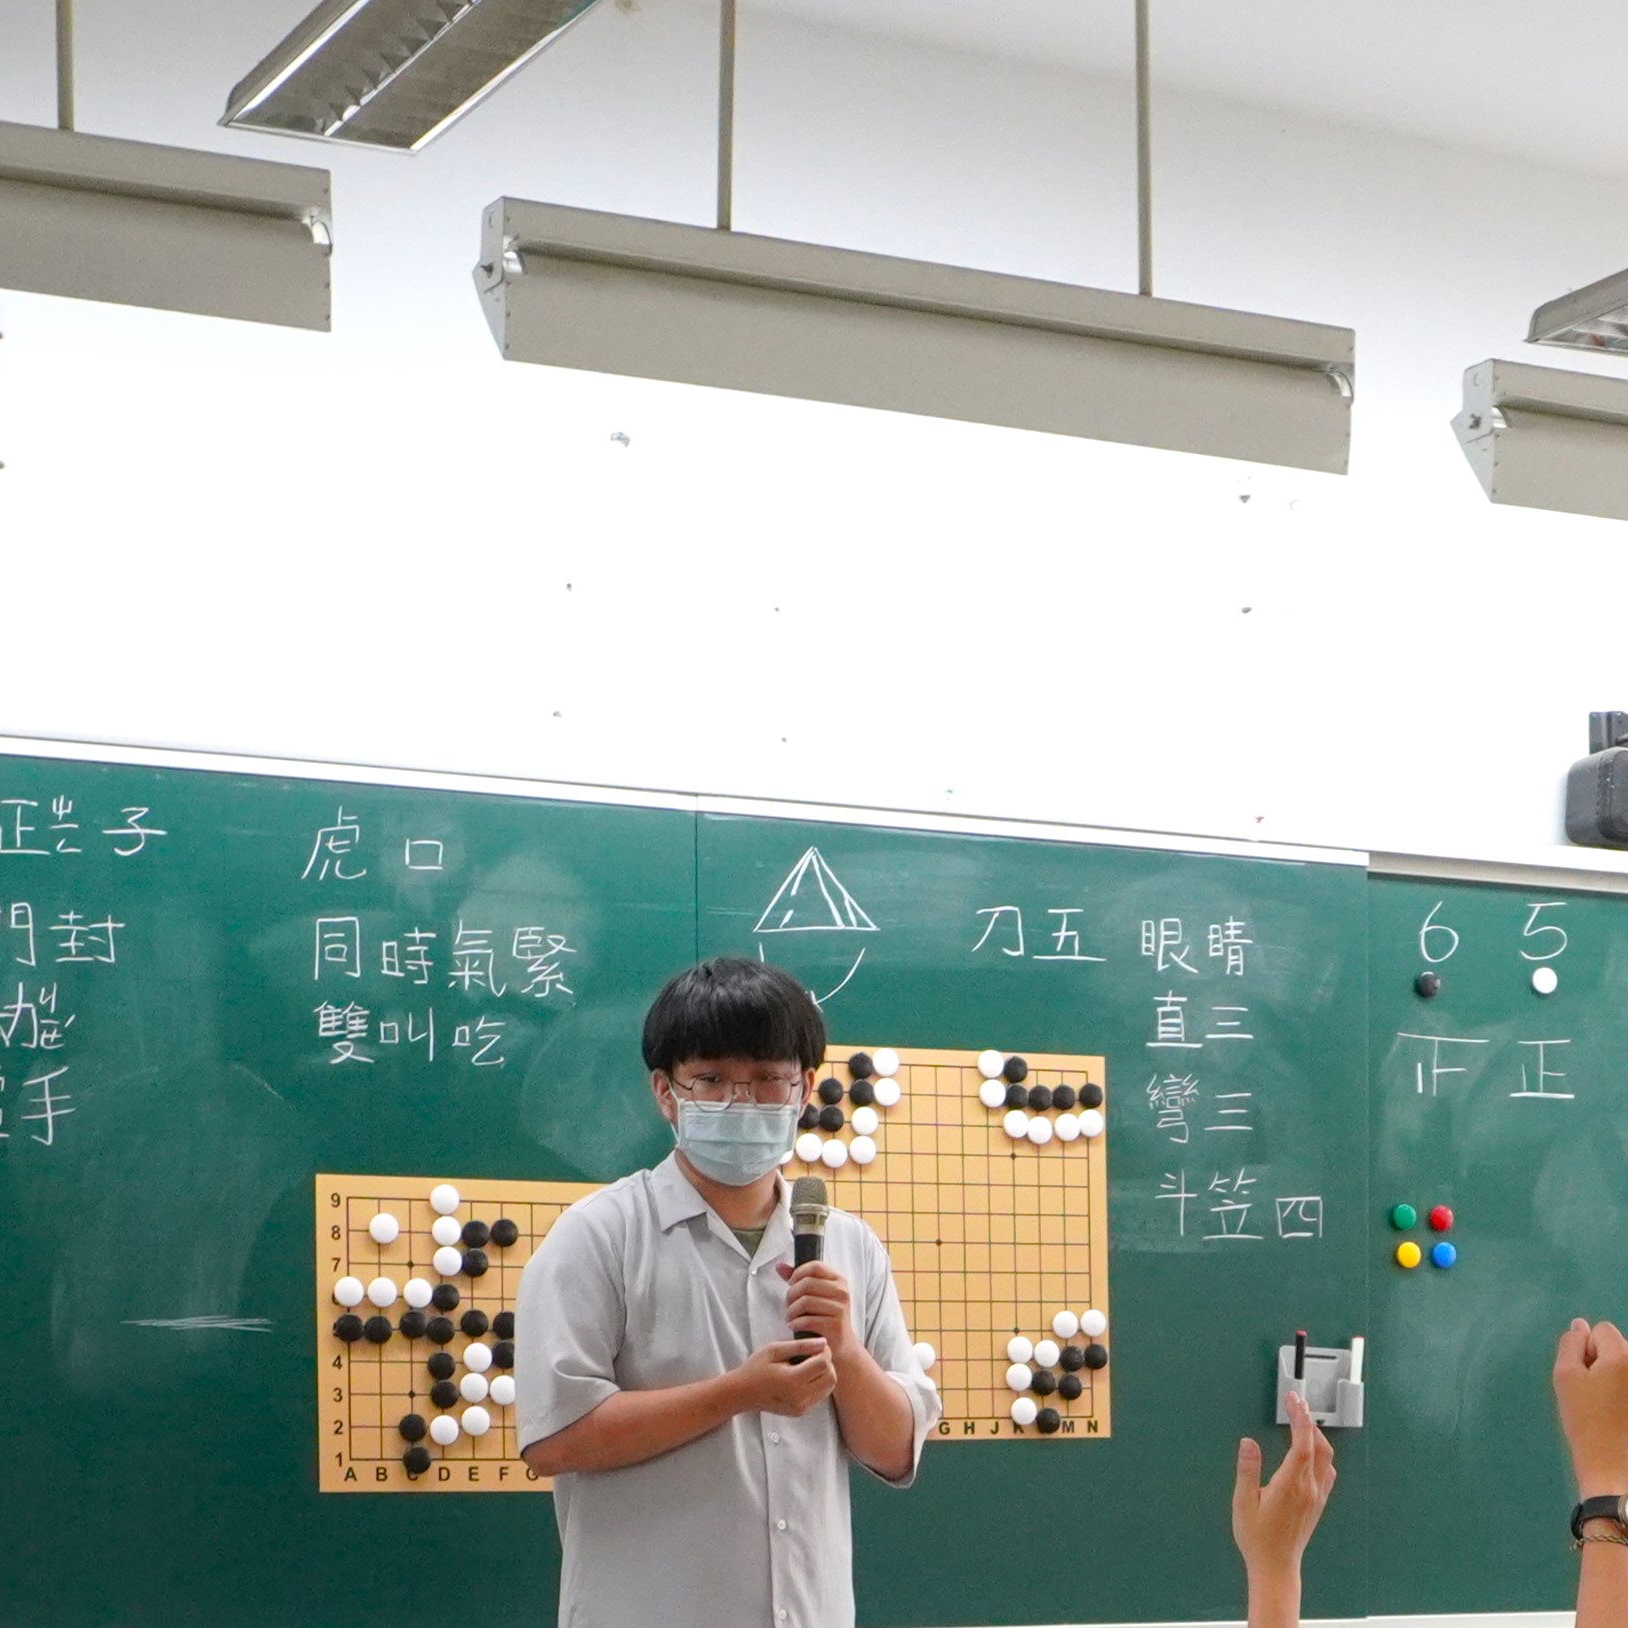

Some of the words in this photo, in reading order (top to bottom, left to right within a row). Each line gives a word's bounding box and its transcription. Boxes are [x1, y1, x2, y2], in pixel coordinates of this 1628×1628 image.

[301, 805, 444, 881] 虎口
[1419, 901, 1460, 963] 6
[1518, 902, 1568, 961] 5
[1141, 916, 1253, 976] 眼睛
[314, 916, 578, 998] 同時氣緊
[1146, 990, 1254, 1048] 直三
[313, 1000, 507, 1065] 雙叫吃
[1146, 1073, 1254, 1144] 彎三
[330, 1194, 341, 1208] 9
[1155, 1167, 1323, 1241] 斗笠四
[331, 1226, 341, 1240] 8
[331, 1258, 342, 1272] 7
[332, 1355, 343, 1369] 4
[333, 1387, 343, 1401] 3
[333, 1420, 344, 1434] 2
[939, 1421, 950, 1435] G
[964, 1421, 976, 1434] H
[990, 1421, 999, 1435] J
[1013, 1420, 1024, 1434] K
[1062, 1420, 1075, 1434] M
[1087, 1420, 1098, 1433] N
[335, 1453, 343, 1466] 1
[344, 1467, 357, 1481] A
[376, 1467, 388, 1481] B
[438, 1467, 450, 1481] D
[468, 1467, 479, 1481] E
[499, 1467, 509, 1481] F
[526, 1467, 539, 1480] G
